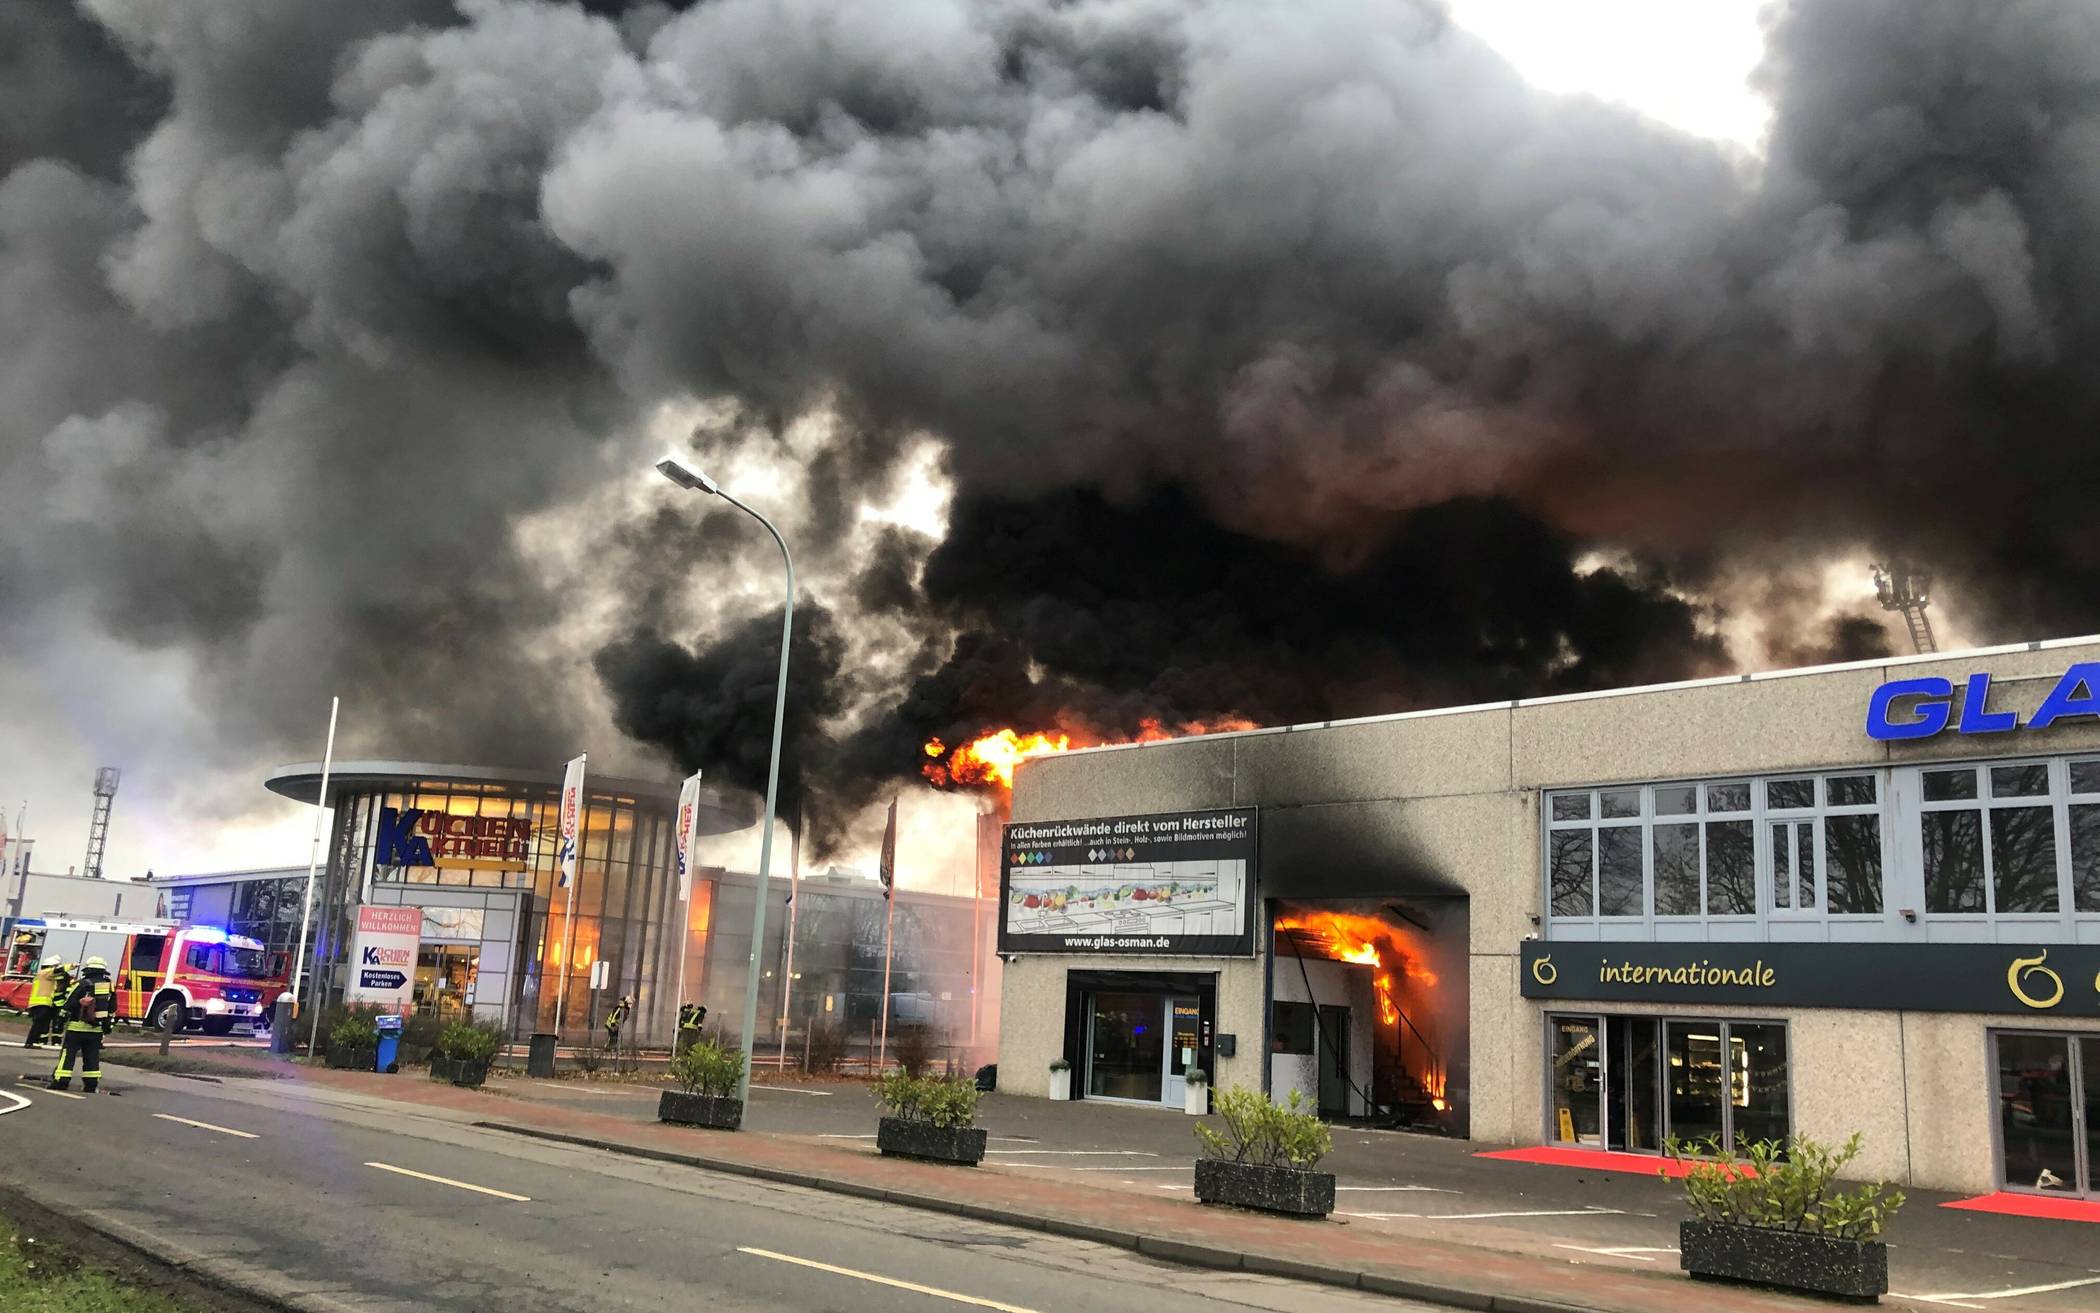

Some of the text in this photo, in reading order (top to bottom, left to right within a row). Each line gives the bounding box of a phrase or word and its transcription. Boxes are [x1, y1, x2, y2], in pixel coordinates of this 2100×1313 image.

[1865, 662, 2100, 741] GLA
[1010, 814, 1247, 839] Küchenrückwände direkt vom Hersteller
[1017, 841, 1031, 849] allen
[1032, 840, 1051, 848] Farben
[1105, 837, 1112, 845] in
[1153, 834, 1172, 843] sowie
[1174, 832, 1214, 842] Bildmotiven
[1216, 830, 1247, 841] möglich!
[371, 911, 412, 921] HERZLICH
[1065, 936, 1170, 949] www.glas-osman.de
[363, 971, 400, 980] Kostenloses
[1600, 959, 1776, 987] internationale
[1561, 1025, 1589, 1033] EINGANG
